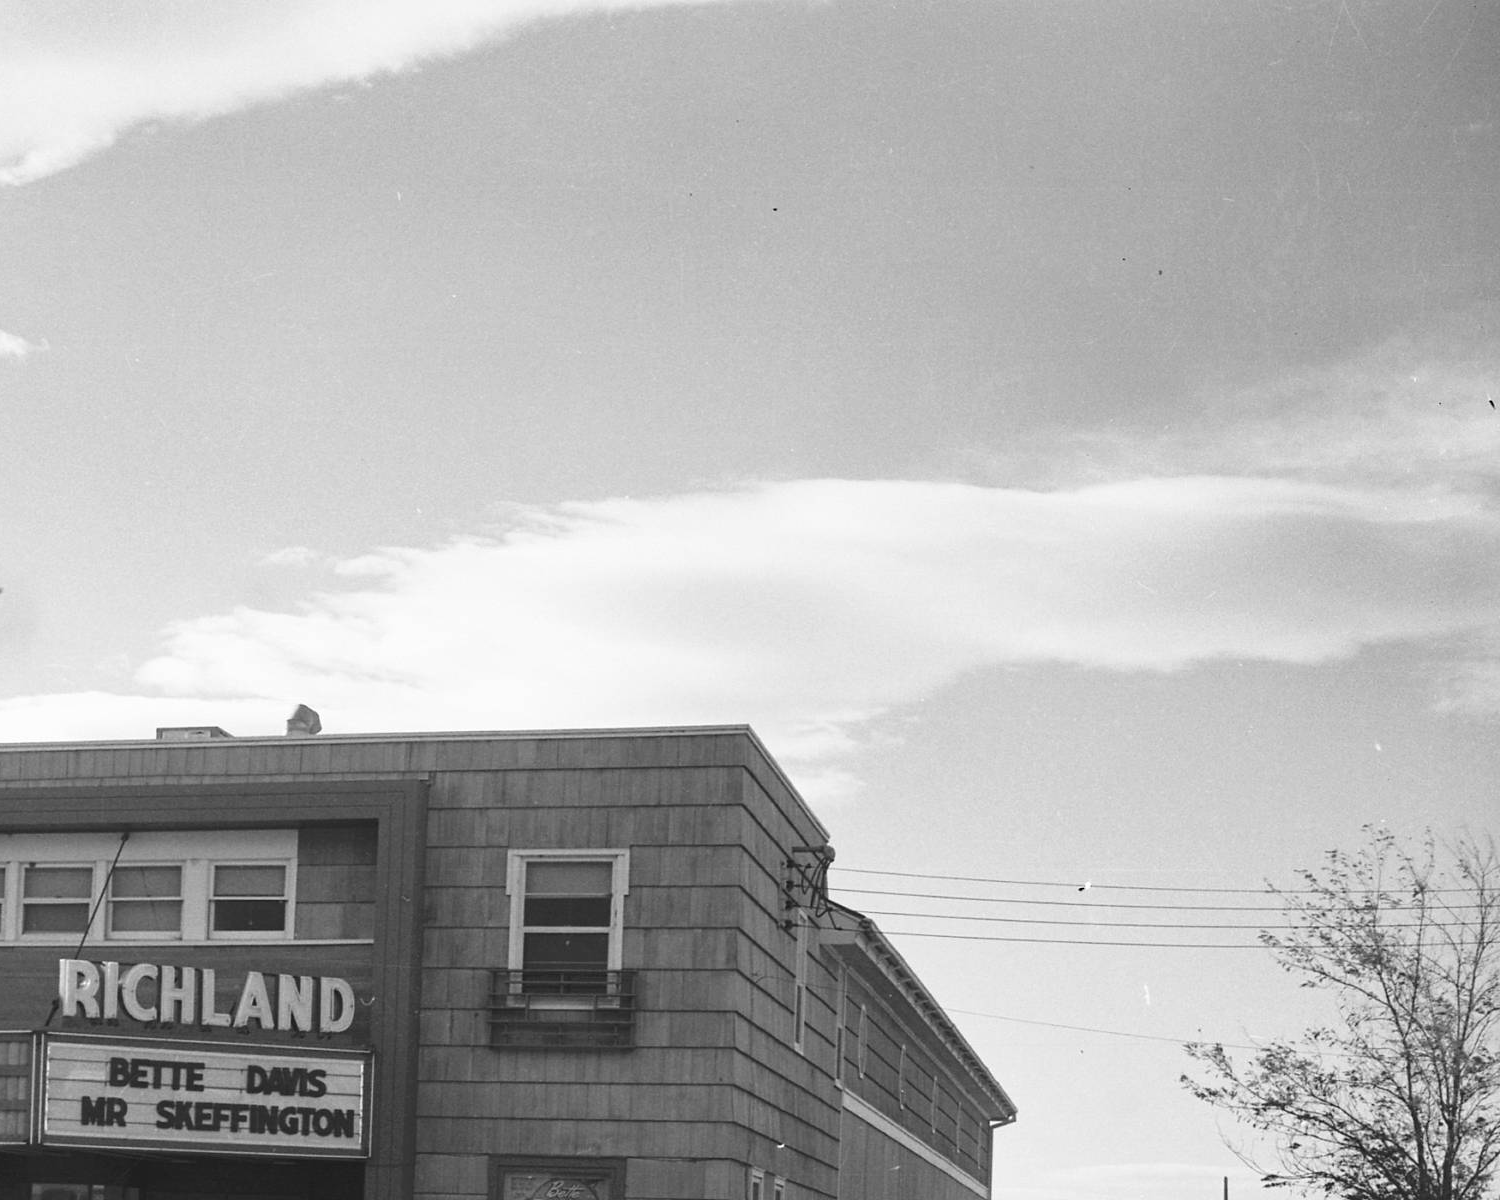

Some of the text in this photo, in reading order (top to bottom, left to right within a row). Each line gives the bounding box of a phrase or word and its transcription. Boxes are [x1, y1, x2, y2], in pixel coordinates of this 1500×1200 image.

[59, 958, 355, 1032] RICHLAND
[109, 1056, 327, 1097] BETTE DAVIS
[80, 1095, 355, 1138] MR SKEFFINGTON
